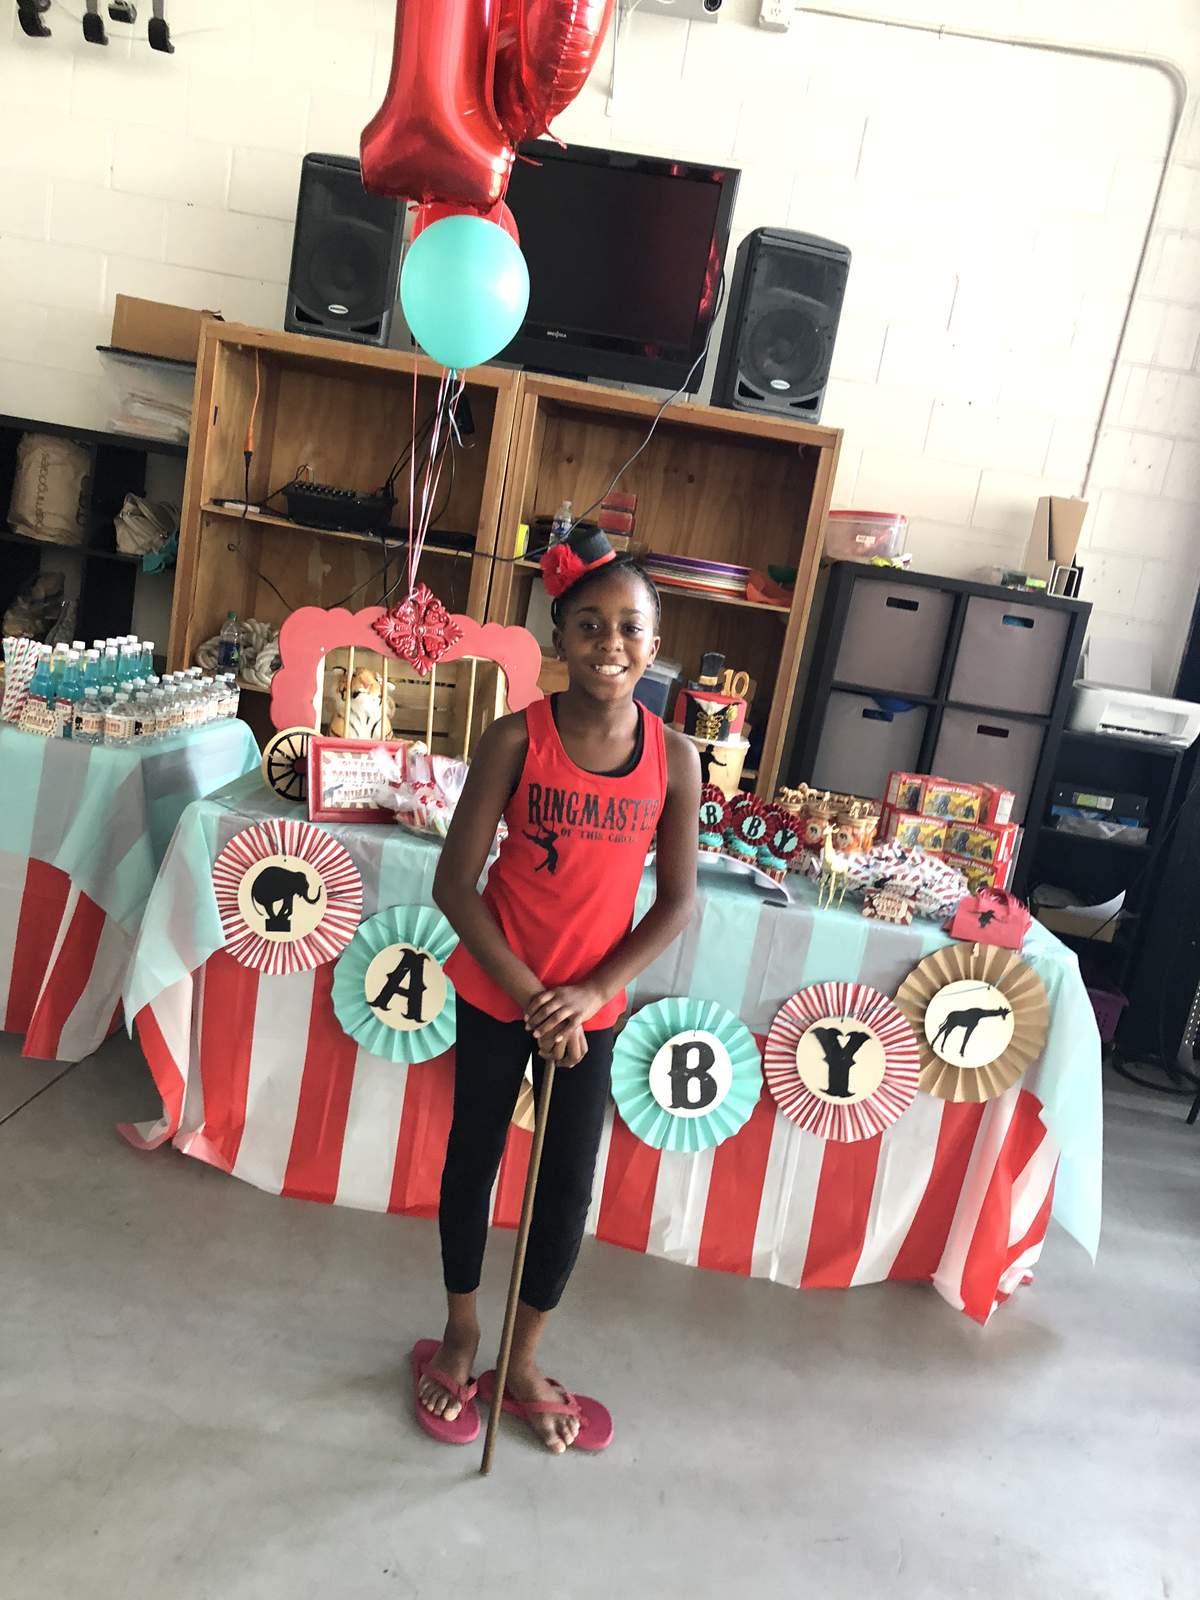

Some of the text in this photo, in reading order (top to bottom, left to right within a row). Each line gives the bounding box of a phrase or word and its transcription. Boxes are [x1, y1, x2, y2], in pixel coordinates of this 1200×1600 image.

[720, 668, 750, 699] 10
[561, 828, 572, 838] OF
[705, 804, 718, 826] B
[748, 818, 762, 838] B
[778, 829, 796, 851] Y
[365, 948, 872, 1110] A B Y
